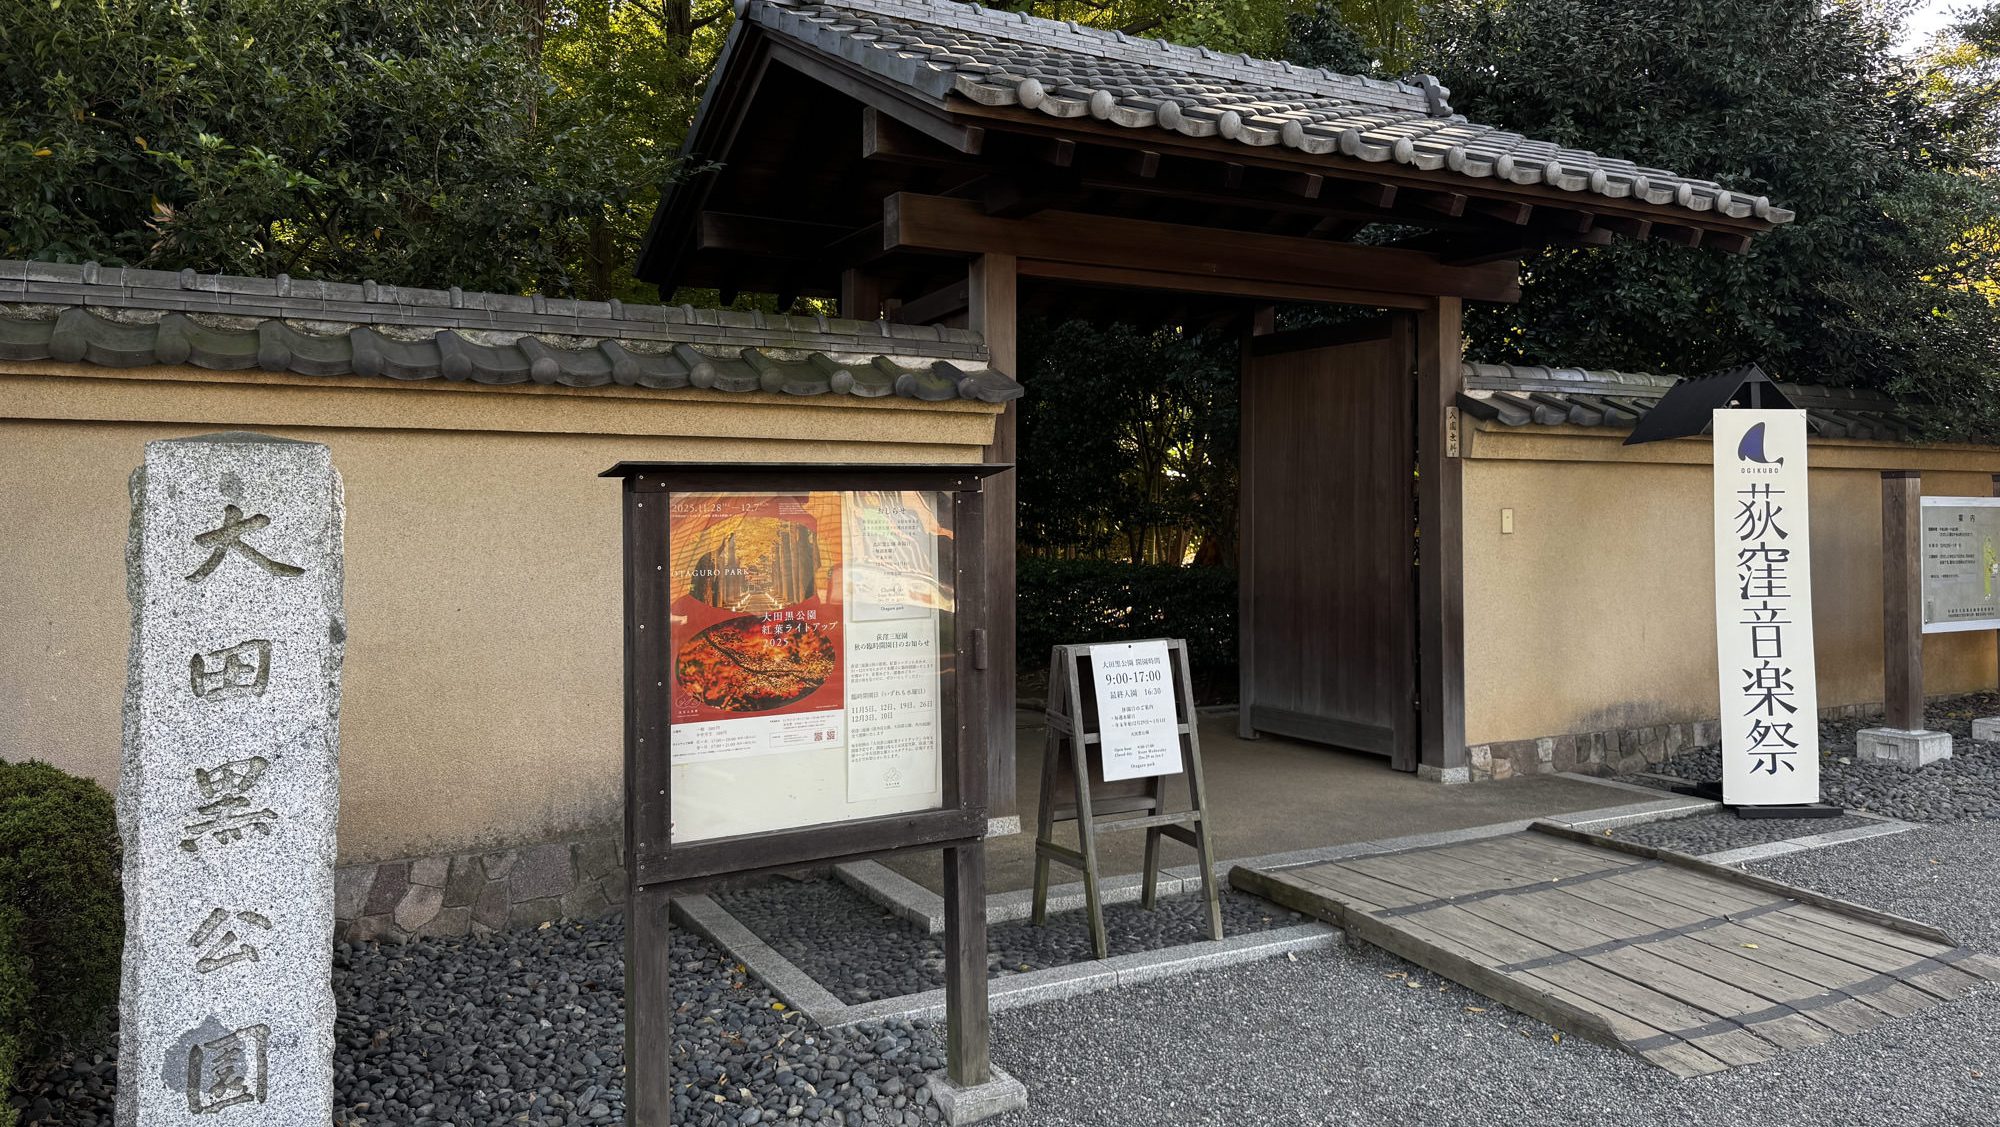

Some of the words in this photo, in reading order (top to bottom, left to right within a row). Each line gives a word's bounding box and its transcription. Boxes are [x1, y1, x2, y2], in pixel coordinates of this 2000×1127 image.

[671, 502, 722, 513] 2025.11.28
[741, 502, 760, 512] 12.7
[671, 569, 721, 578] OTAGURO
[724, 567, 750, 576] PARK
[761, 609, 817, 623] 大田黒公園
[761, 620, 839, 635] 紅葉ライトアップ
[1734, 483, 1799, 775] 荻窪音楽祭
[763, 637, 789, 647] 2025
[1105, 670, 1161, 686] 9:00-17:00
[180, 503, 306, 1115] 大田黒公園
